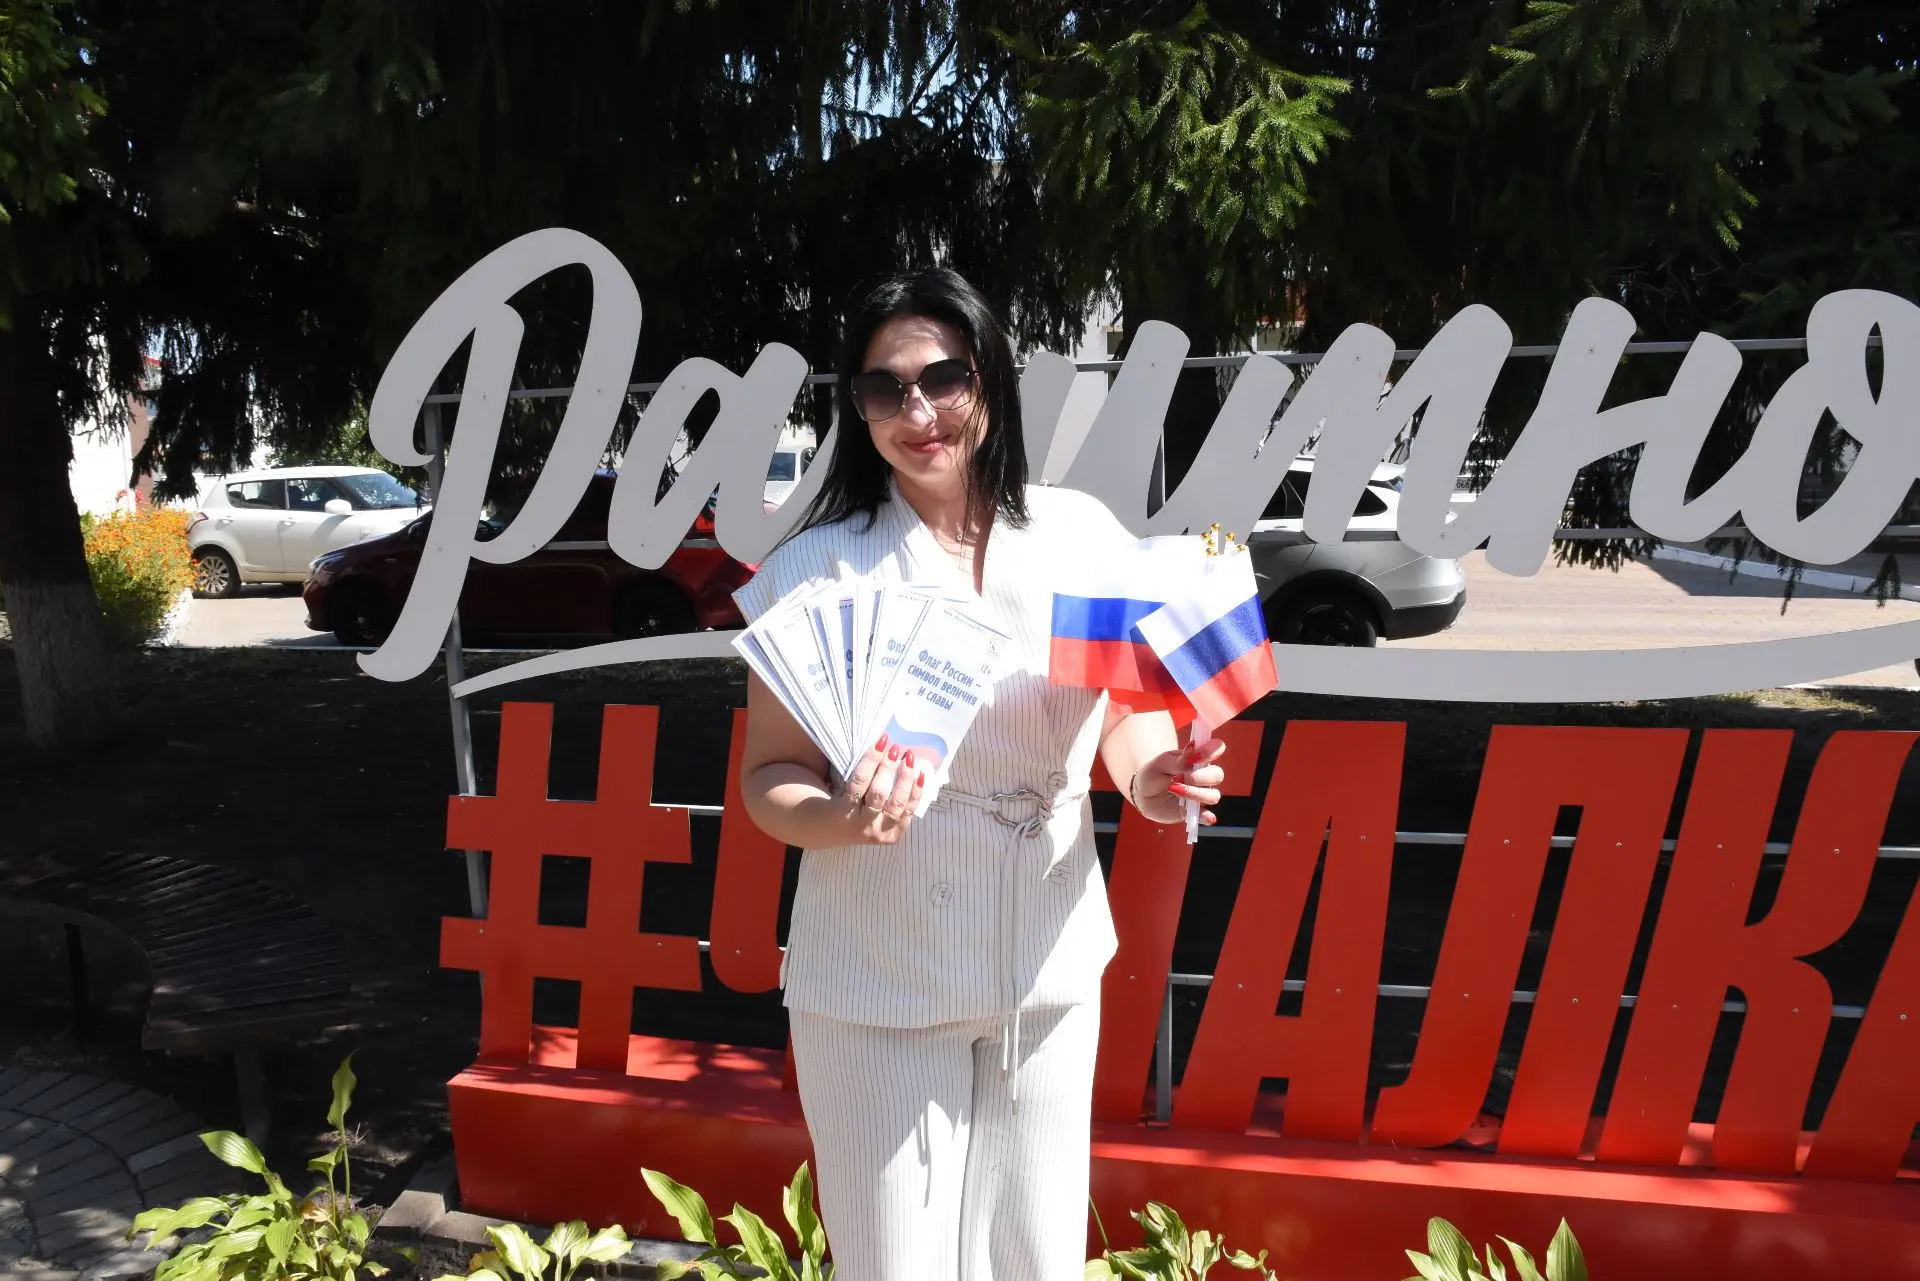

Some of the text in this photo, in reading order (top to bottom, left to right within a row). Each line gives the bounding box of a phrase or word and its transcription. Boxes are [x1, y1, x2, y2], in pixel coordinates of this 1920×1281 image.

[907, 664, 978, 706] символ величия
[918, 649, 942, 670] Флаг
[941, 660, 974, 687] России
[926, 691, 954, 711] славы
